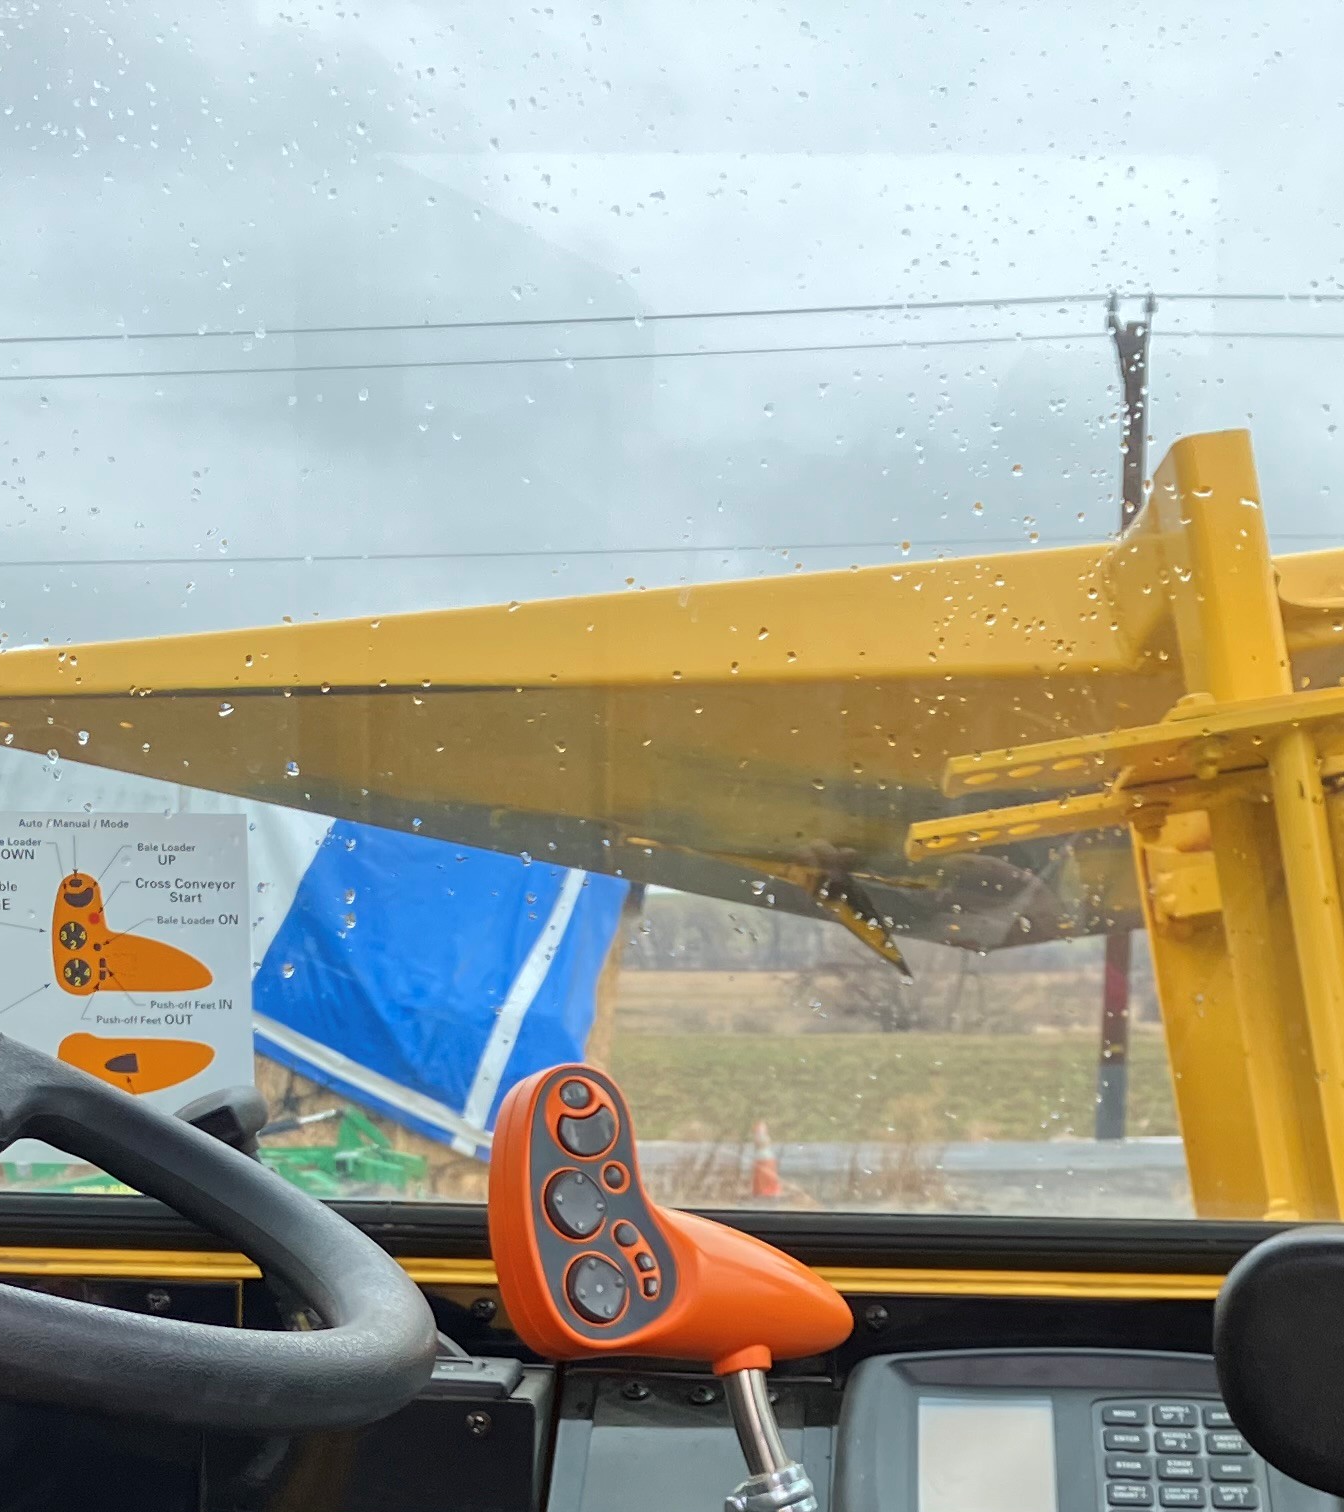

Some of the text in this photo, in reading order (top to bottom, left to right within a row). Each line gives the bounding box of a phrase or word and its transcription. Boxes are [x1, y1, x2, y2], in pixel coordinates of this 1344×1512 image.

[18, 819, 43, 829] Auto
[53, 819, 90, 829] Manual
[100, 819, 129, 829] Mode
[7, 838, 42, 847] Loader
[137, 843, 196, 853] Bale Loader
[158, 855, 176, 866] UP
[135, 878, 236, 891] Cross Conveyor
[170, 891, 202, 903] Start
[157, 914, 239, 925] Bale Loader ON
[60, 931, 68, 940] 3
[79, 931, 87, 940] 4
[70, 941, 77, 950] 2
[64, 967, 72, 977] 3
[83, 968, 91, 977] 4
[74, 977, 82, 987] 2
[150, 999, 233, 1010] Push-off Feet IN
[96, 1014, 193, 1025] Push-off Feet OUT
